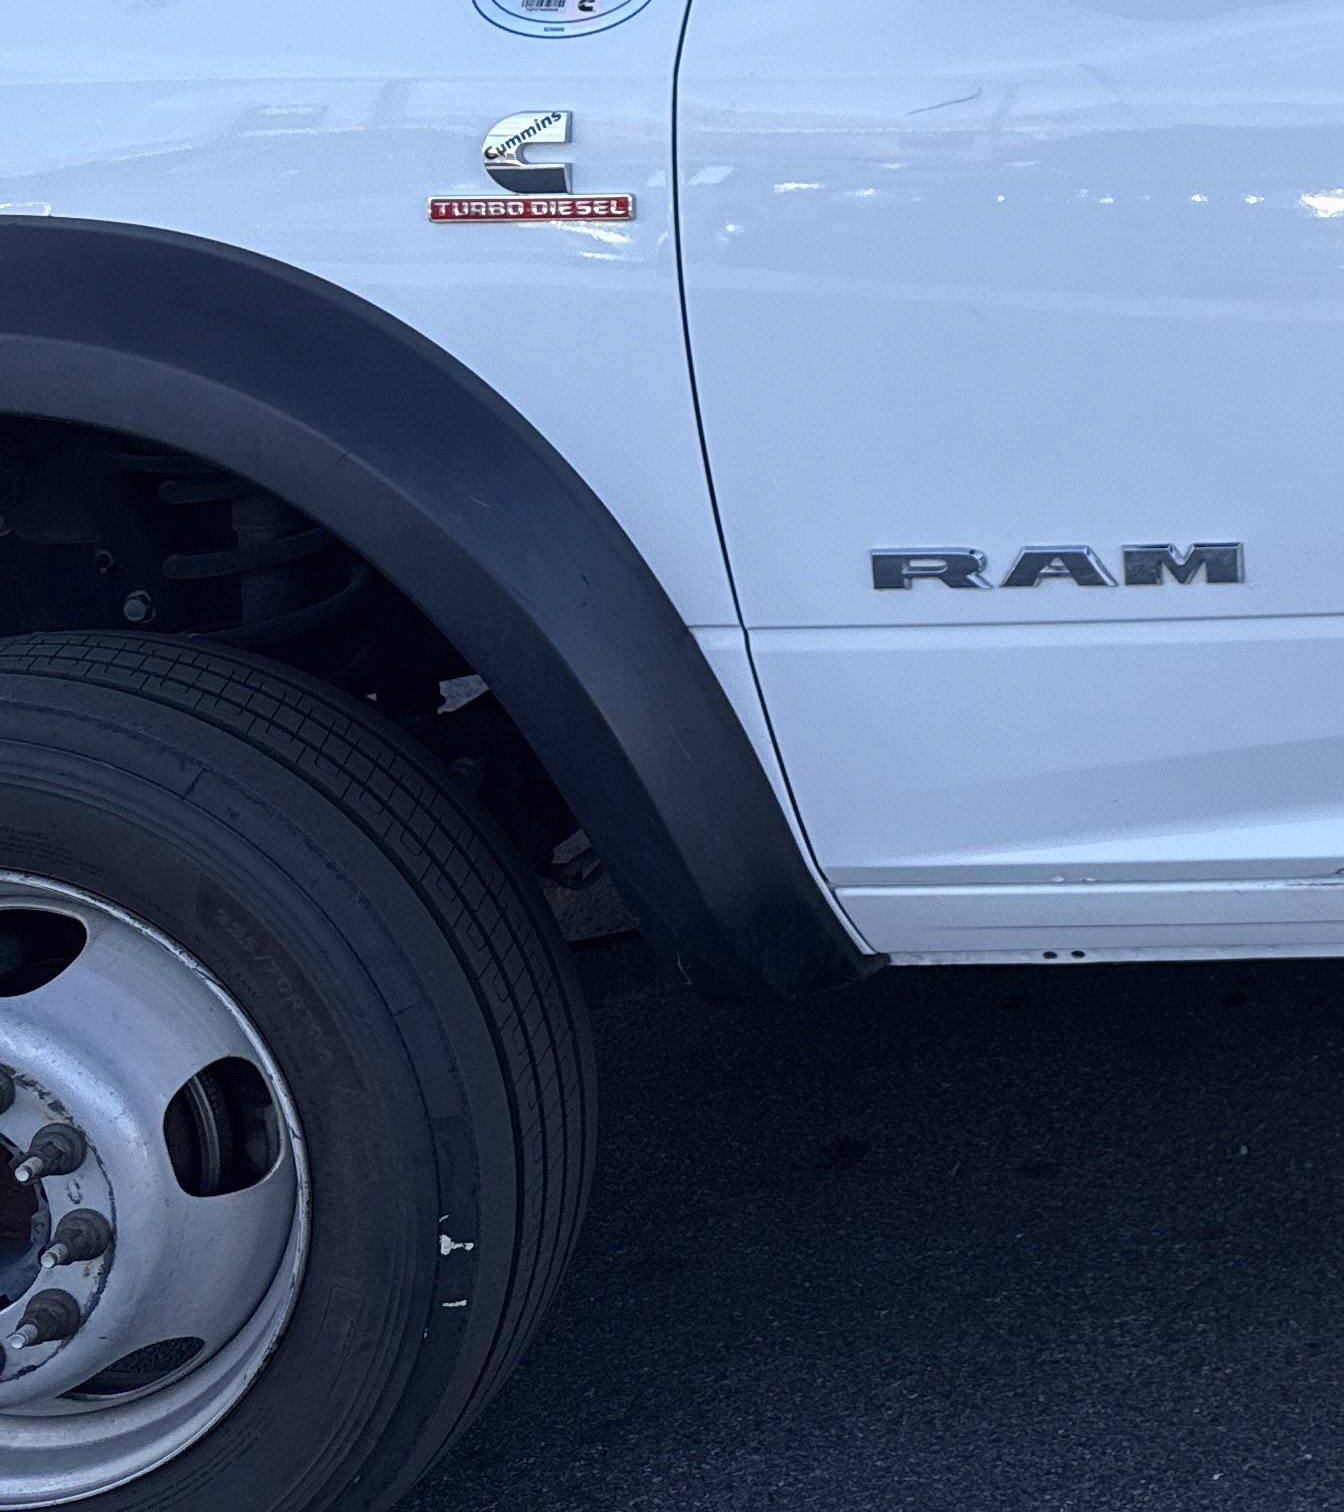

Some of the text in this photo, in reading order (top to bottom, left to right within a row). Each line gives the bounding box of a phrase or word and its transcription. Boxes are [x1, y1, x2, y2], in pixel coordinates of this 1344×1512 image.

[484, 111, 562, 161] Cummins
[433, 199, 628, 217] TURBO DIESEL
[870, 541, 1245, 590] RAM
